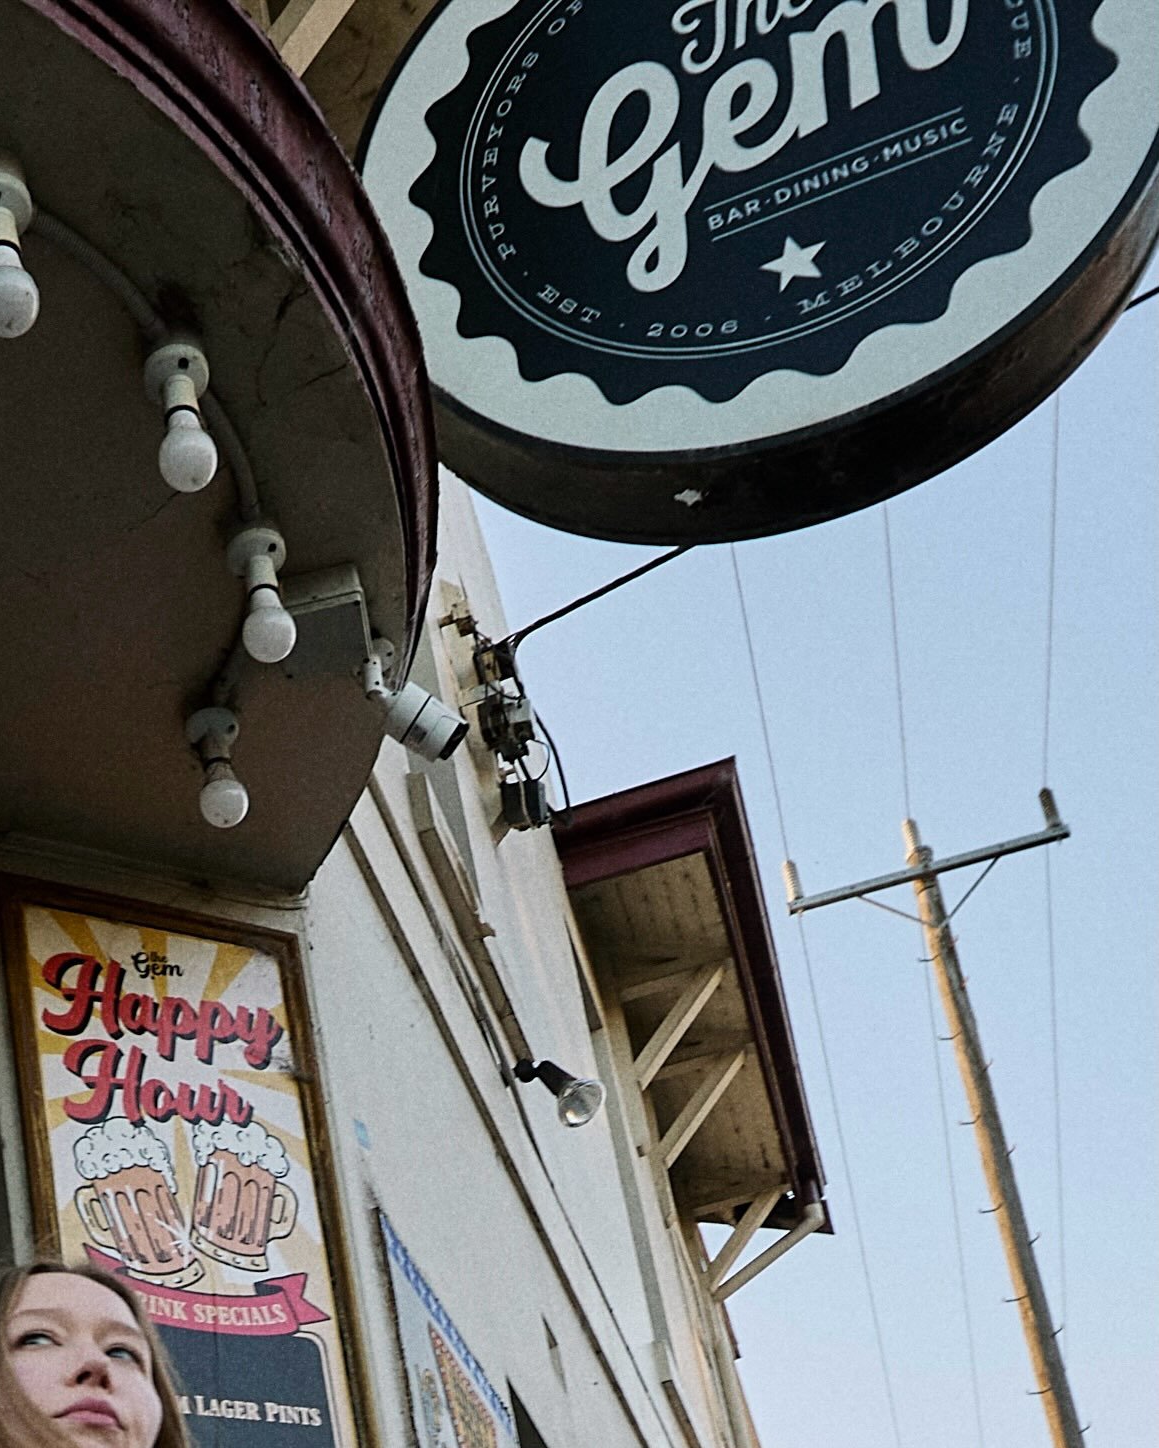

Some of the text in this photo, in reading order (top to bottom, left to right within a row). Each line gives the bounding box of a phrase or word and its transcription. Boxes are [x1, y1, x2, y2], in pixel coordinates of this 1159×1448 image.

[481, 51, 540, 261] PURVEYORS
[518, 0, 969, 292] Gem
[536, 283, 601, 323] EST
[797, 103, 1019, 315] MELBOURNE
[42, 951, 283, 1070] Happy
[131, 951, 184, 979] Gem
[62, 1038, 254, 1127] Hour
[139, 1292, 288, 1326] INK SPECIALS
[193, 1395, 262, 1421] LAGER
[264, 1402, 323, 1427] PINTS
